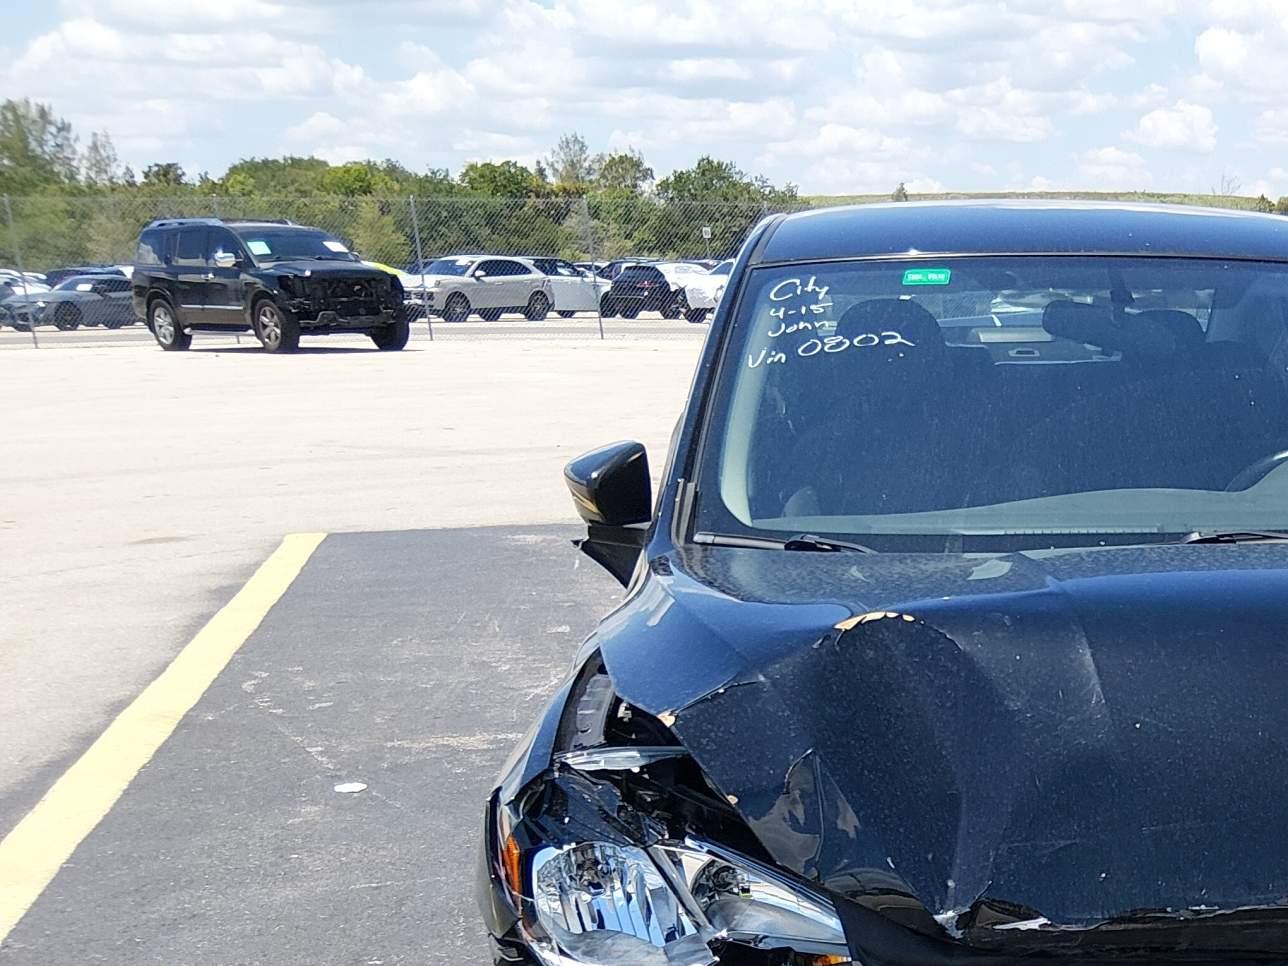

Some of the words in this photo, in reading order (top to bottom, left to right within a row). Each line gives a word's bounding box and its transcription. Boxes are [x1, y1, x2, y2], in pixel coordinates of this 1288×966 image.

[769, 276, 830, 301] City
[769, 302, 833, 319] 4-15
[767, 319, 836, 337] John
[747, 349, 787, 368] Vin
[797, 331, 916, 357] 0802
